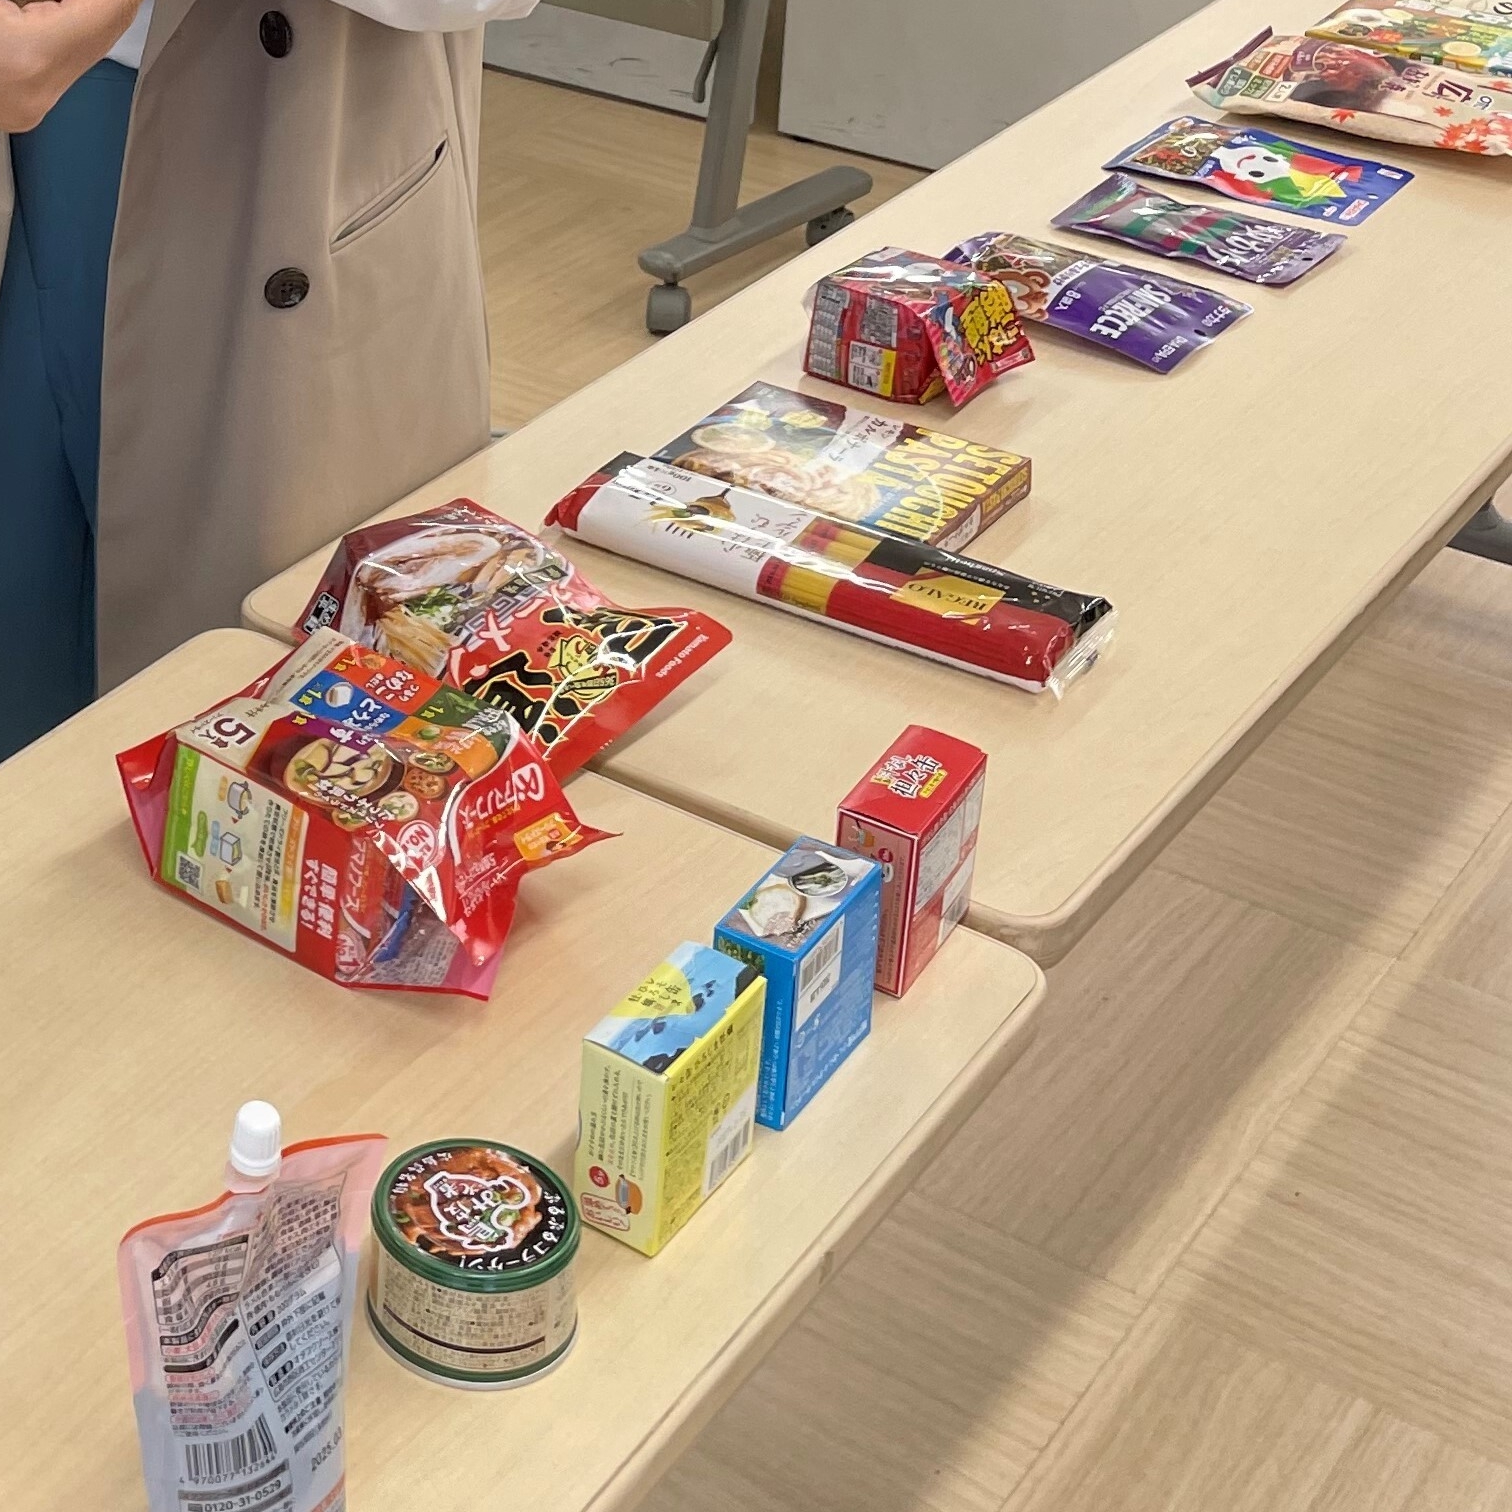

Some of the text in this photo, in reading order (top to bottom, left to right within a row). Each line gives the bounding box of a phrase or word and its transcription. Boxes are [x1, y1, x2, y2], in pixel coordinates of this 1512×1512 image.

[1089, 281, 1173, 341] SANFRECCE
[827, 418, 887, 463] カルボナーラ
[858, 428, 968, 490] PASTA
[874, 446, 1023, 541] SETOUCHI
[908, 581, 987, 612] REGALO
[654, 632, 709, 680] Yamato Foods
[457, 780, 518, 830] アマノフーズ
[345, 840, 366, 911] アマノフーズ
[204, 1479, 282, 1512] 0120-31-0529
